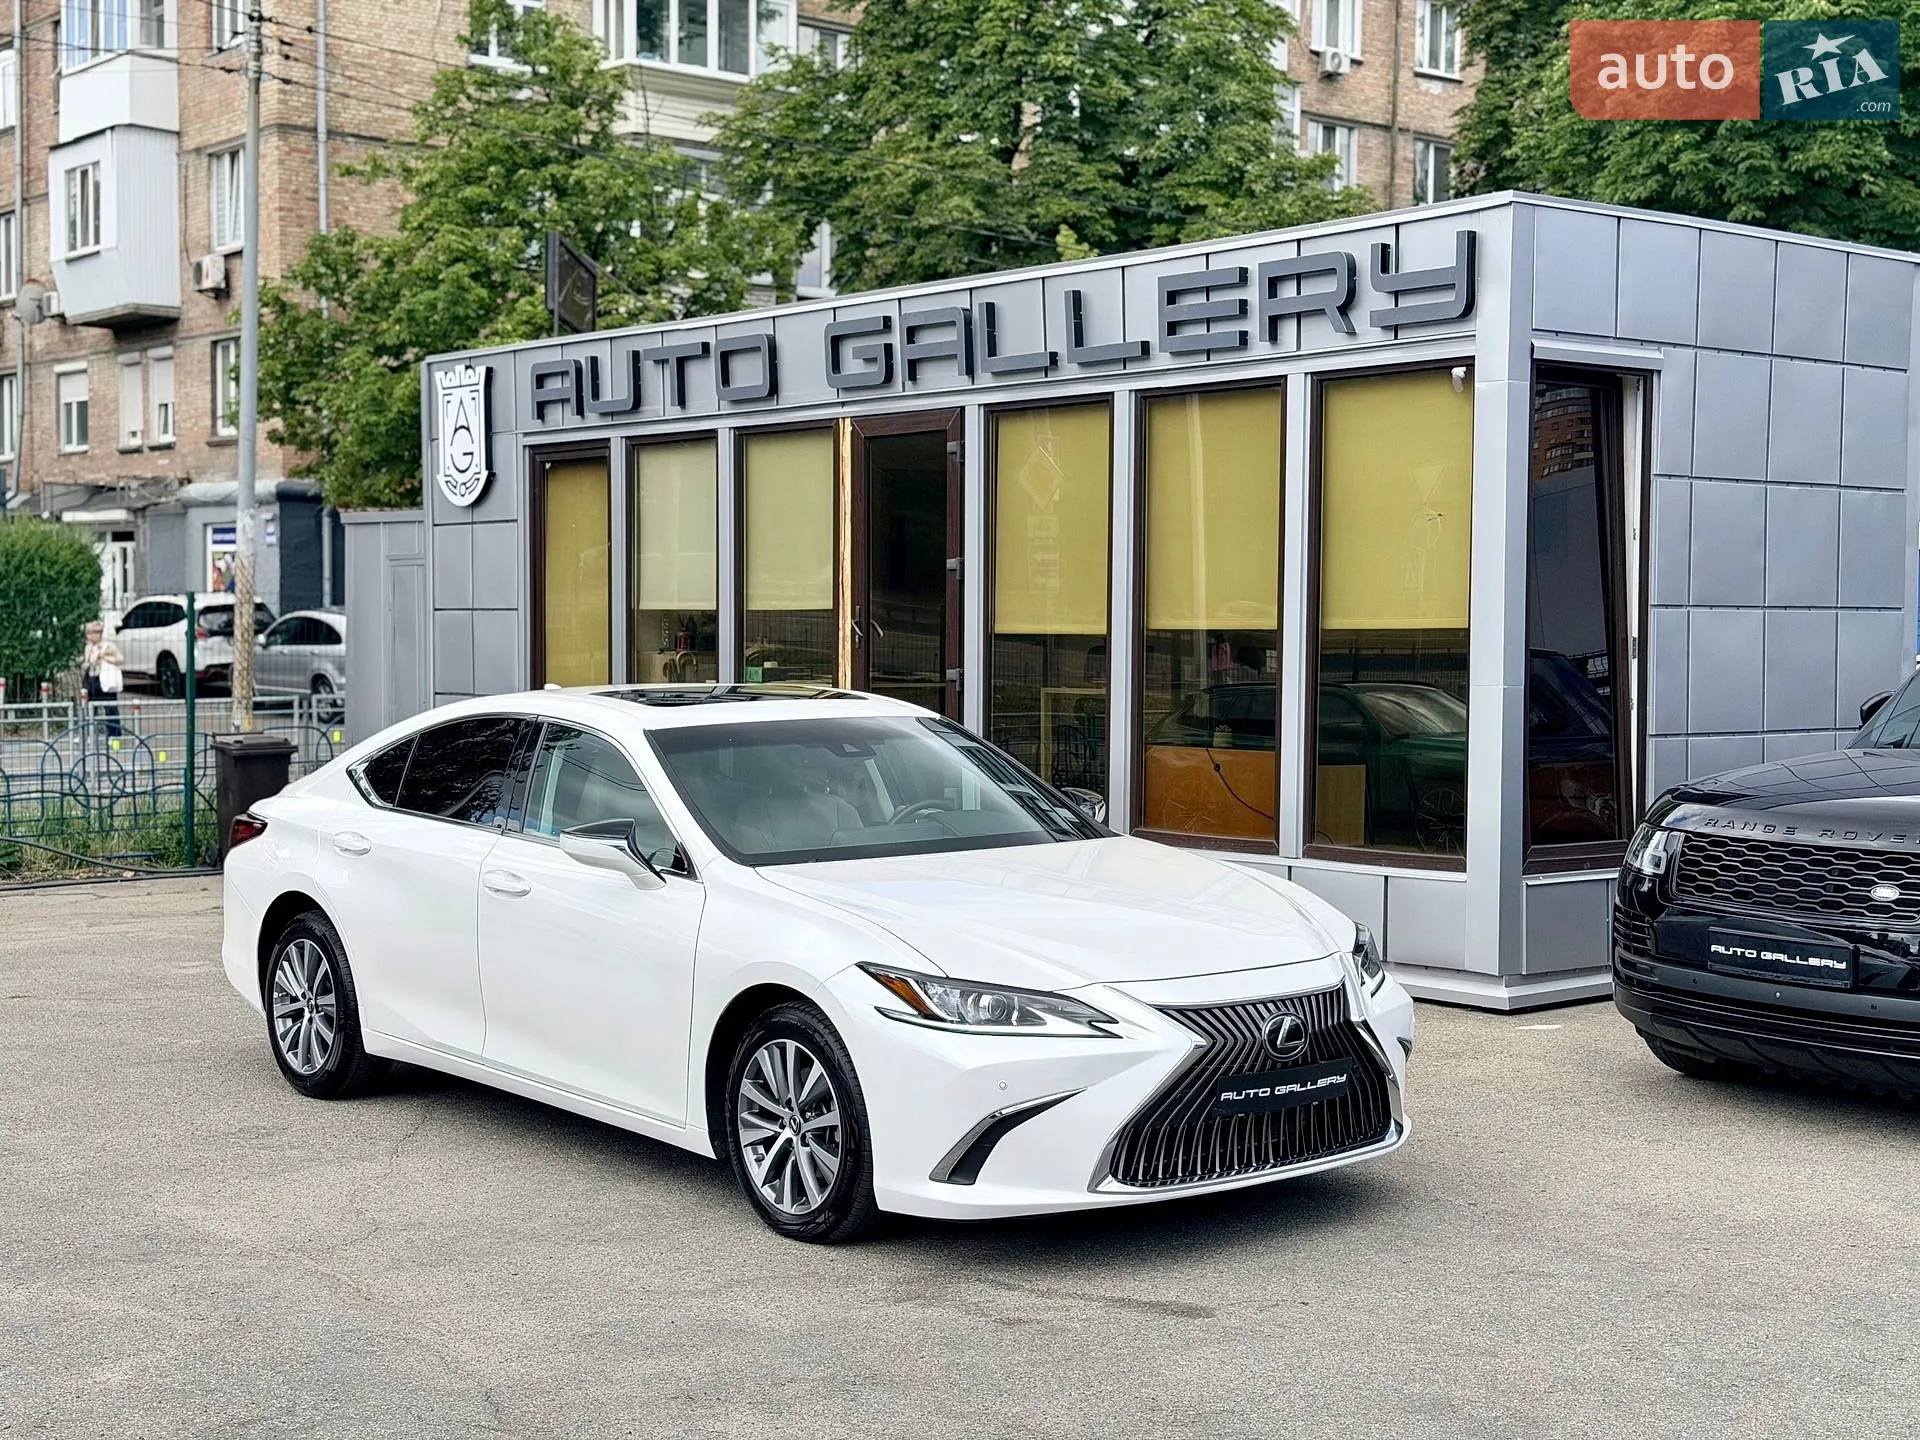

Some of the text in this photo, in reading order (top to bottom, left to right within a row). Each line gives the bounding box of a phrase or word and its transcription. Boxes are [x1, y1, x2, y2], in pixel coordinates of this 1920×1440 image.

[530, 229, 1477, 421] AUTO GALLERY
[1703, 817, 1799, 836] RANGE
[1710, 944, 1848, 970] AUTO GALLERY
[1220, 1073, 1348, 1102] AUTO GALLERY
